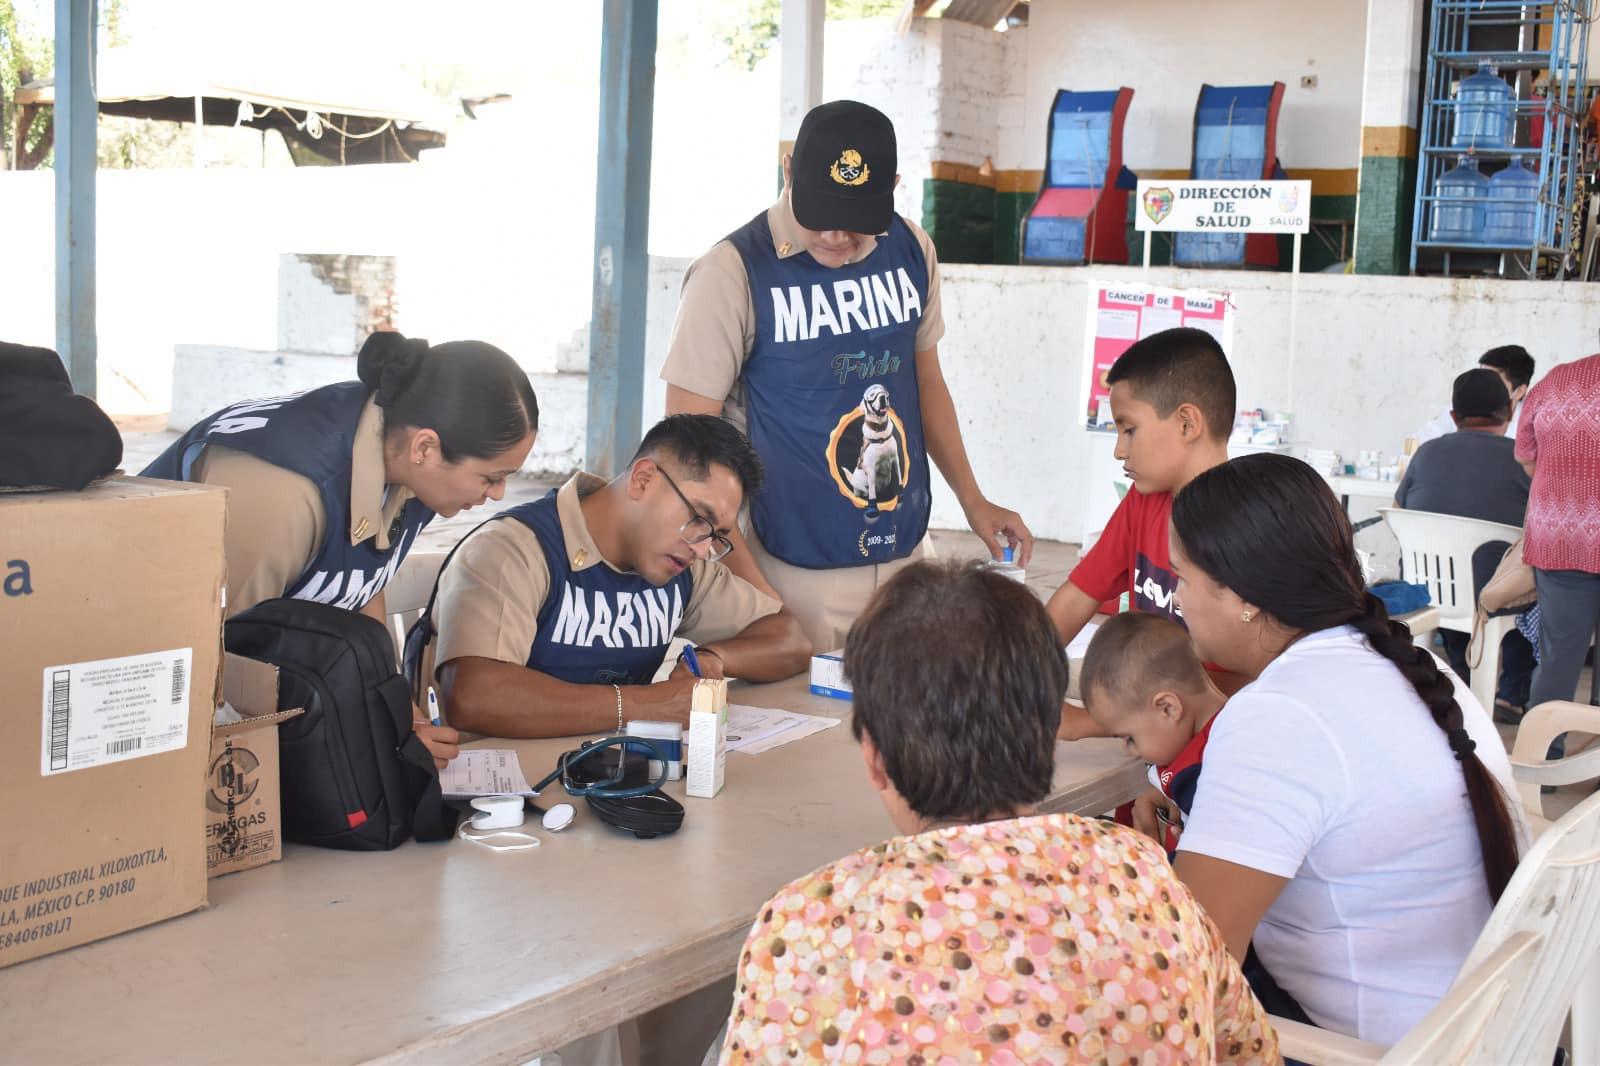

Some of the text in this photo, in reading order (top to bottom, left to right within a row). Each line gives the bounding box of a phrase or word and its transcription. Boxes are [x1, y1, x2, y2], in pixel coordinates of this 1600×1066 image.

[1179, 184, 1272, 199] DIRECCIÓN
[1213, 202, 1236, 213] DE
[1195, 216, 1252, 228] SALUD
[1269, 217, 1304, 226] SALUD
[770, 267, 922, 343] MARINA
[1156, 297, 1169, 305] DE
[831, 350, 901, 384] Frida
[551, 580, 684, 648] MARINA
[23, 866, 95, 898] INDUSTRIAL
[98, 848, 168, 878] XILOXOXTLA,
[25, 894, 72, 920] MÉXICO
[75, 888, 95, 907] C.P.
[99, 877, 136, 900] 90180
